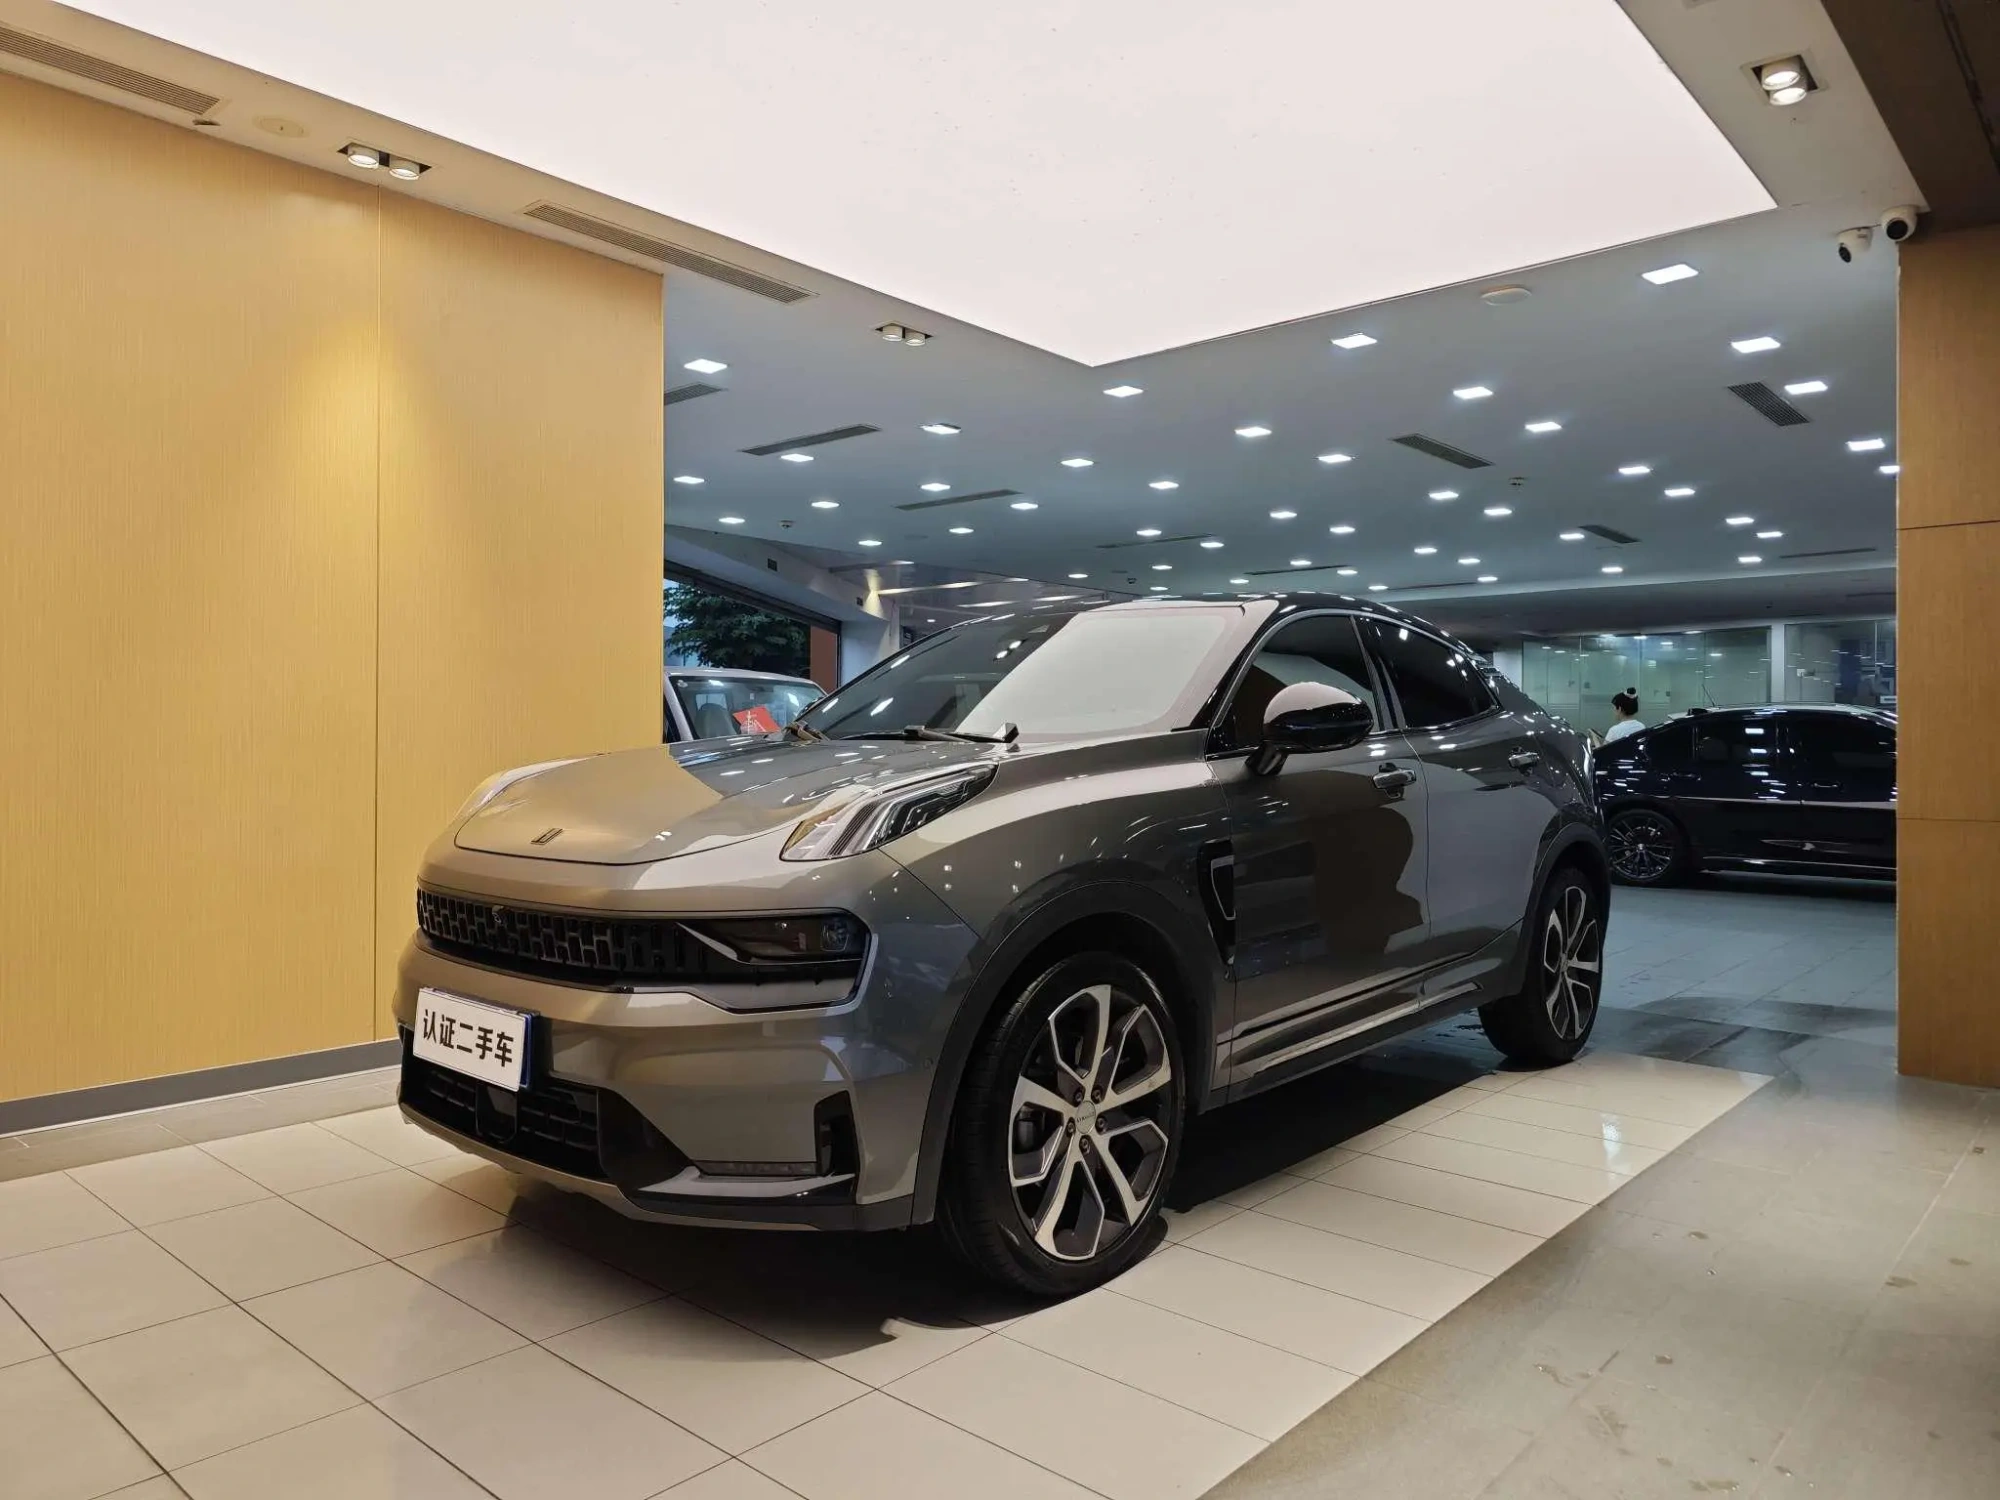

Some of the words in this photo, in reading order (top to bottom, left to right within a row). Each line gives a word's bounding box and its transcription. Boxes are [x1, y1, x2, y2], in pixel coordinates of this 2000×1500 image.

[423, 1009, 514, 1067] 认证二手车
